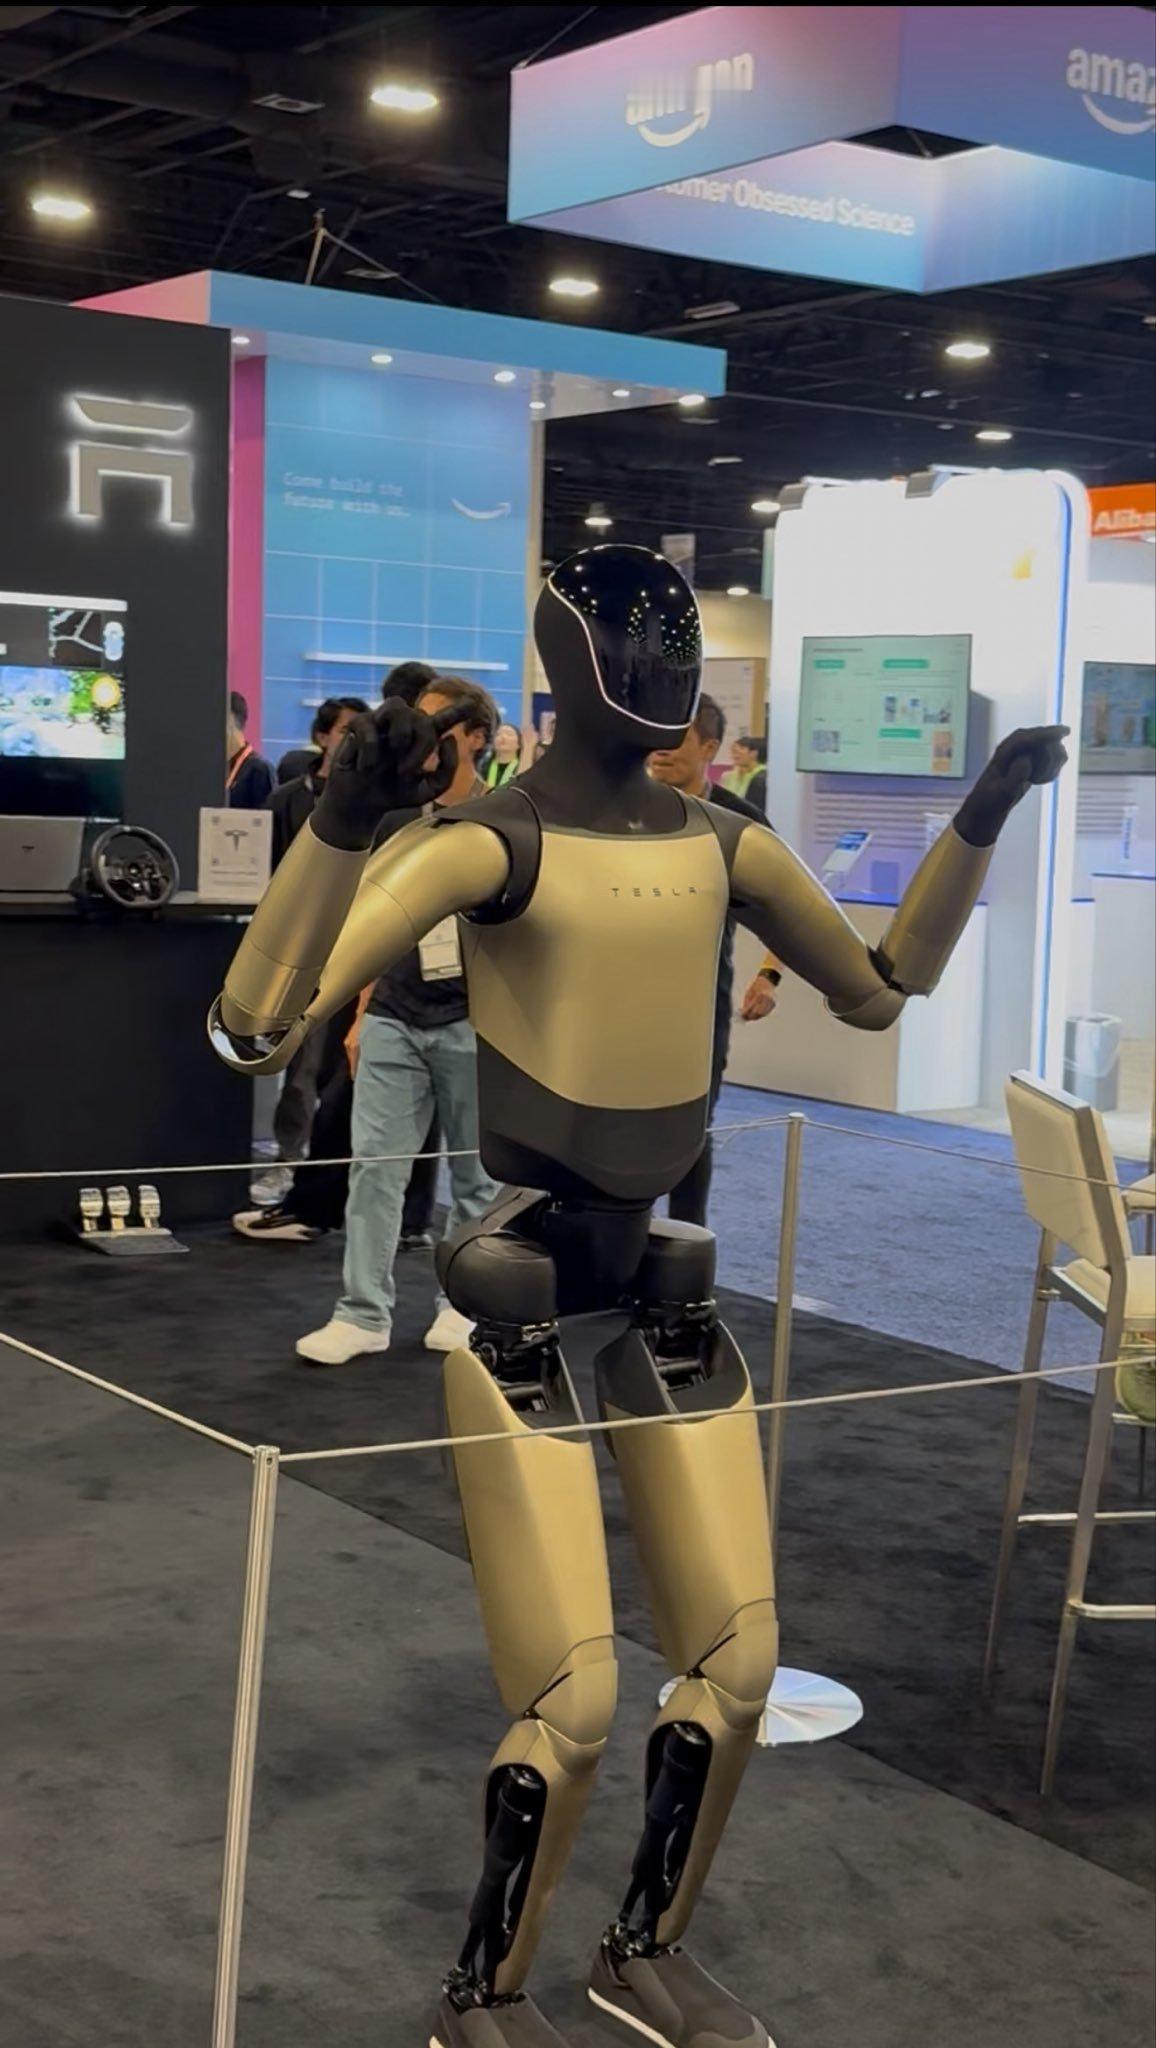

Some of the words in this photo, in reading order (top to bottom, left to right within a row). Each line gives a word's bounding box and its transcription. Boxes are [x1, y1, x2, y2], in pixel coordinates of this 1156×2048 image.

[734, 180, 834, 222] Obsessed
[837, 199, 915, 235] Science
[284, 472, 322, 487] Come
[611, 886, 697, 897] TESLA
